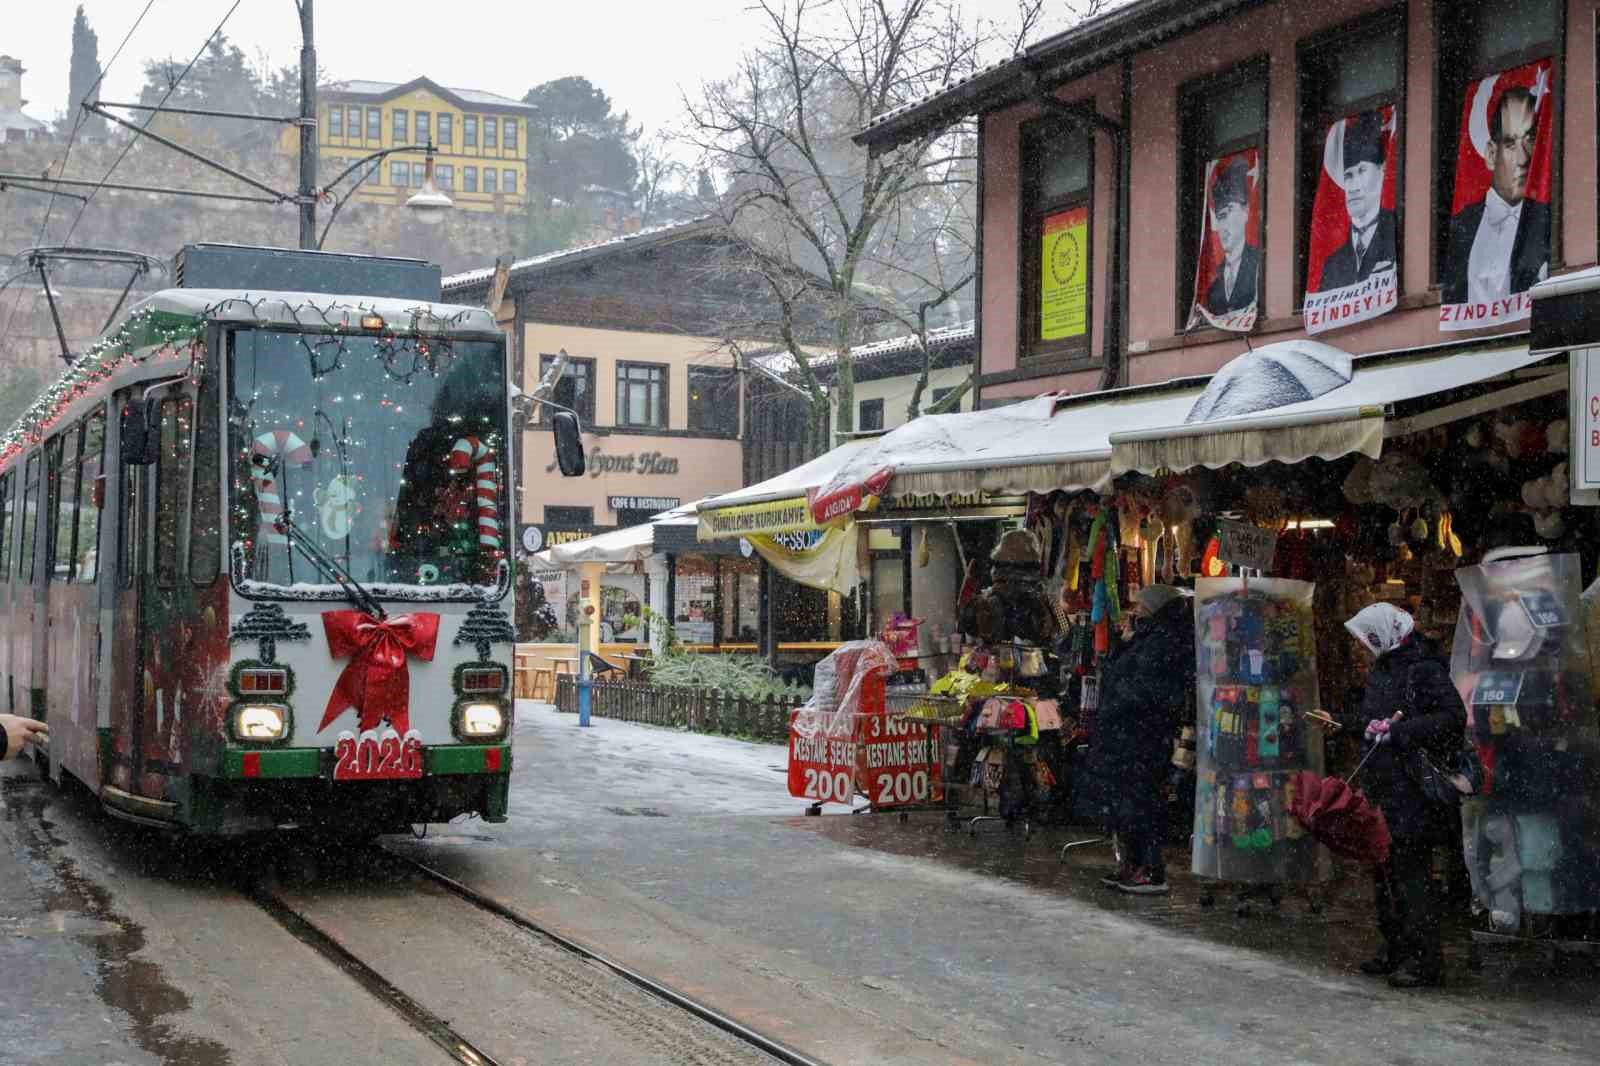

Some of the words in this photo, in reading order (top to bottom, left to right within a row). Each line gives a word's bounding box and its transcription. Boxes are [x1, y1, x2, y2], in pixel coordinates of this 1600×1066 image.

[870, 715, 880, 737] 3
[334, 730, 424, 780] 2026
[865, 739, 906, 769] KESTANE
[804, 767, 850, 801] 200
[876, 770, 928, 804] 200
